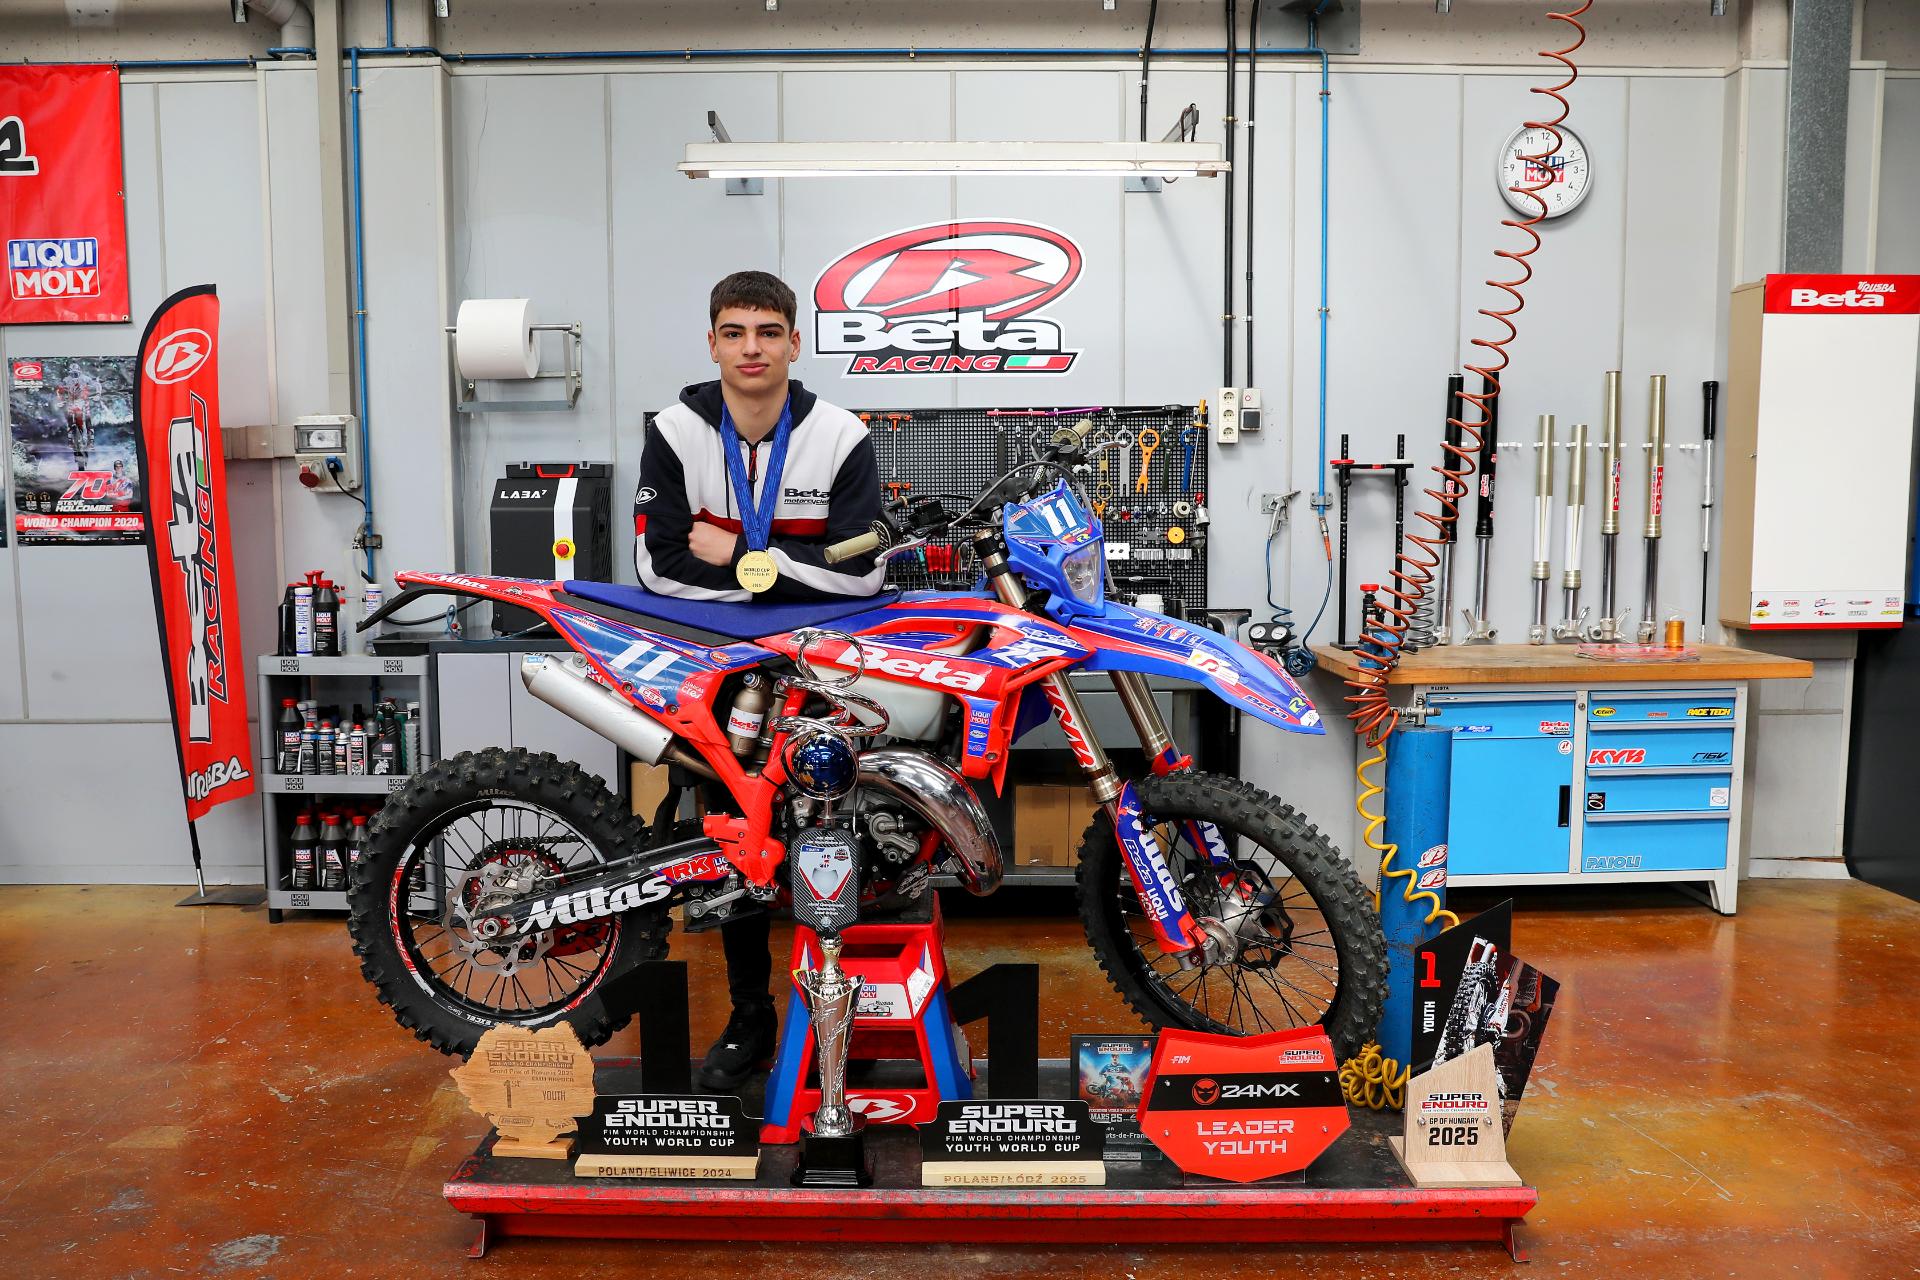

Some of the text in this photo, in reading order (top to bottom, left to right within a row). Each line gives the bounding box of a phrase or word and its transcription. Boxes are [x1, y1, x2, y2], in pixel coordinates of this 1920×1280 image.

[1526, 137, 1534, 145] 11
[1541, 132, 1551, 141] 12
[1570, 150, 1575, 158] 2
[1526, 169, 1564, 181] MOY
[1573, 166, 1579, 174] 3
[1556, 193, 1562, 202] 5
[12, 240, 94, 268] LIQUI
[14, 269, 97, 296] MOLY
[1791, 288, 1884, 307] Beta
[817, 310, 1061, 352] Beta
[851, 355, 1002, 372] RACING
[59, 470, 114, 500] 70
[1655, 465, 1664, 515] Beta
[784, 487, 831, 498] Beta
[24, 517, 139, 528] WORLD CHAMPION 2020
[1040, 497, 1078, 537] 11
[169, 420, 210, 738] Beta
[437, 574, 490, 590] Mitas
[196, 486, 224, 697] RACING
[609, 640, 683, 682] 11
[835, 644, 987, 692] Beta
[972, 710, 990, 719] LIQUI
[1686, 708, 1731, 716] RACE TECH
[971, 716, 989, 725] MOLY
[1588, 750, 1645, 765] KYB
[671, 856, 711, 882] RK
[1123, 838, 1154, 886] Beta
[1586, 856, 1641, 869] PAIOLI
[518, 874, 672, 935] Mitas
[1138, 892, 1160, 923] MOLY
[1146, 887, 1169, 921] LIQUI
[1420, 951, 1441, 988] 1
[856, 1003, 890, 1013] eta
[466, 1013, 492, 1026] EXCEL
[1422, 1000, 1436, 1034] YOUTH
[495, 1040, 566, 1051] SUPER
[487, 1051, 575, 1064] ENDURO
[1170, 1055, 1192, 1064] FIM
[542, 1090, 567, 1101] YOUTH
[1220, 1083, 1301, 1098] 24MX
[1428, 1093, 1483, 1101] SUPER
[616, 1099, 719, 1114] SUPER
[960, 1104, 1065, 1119] SUPER
[1421, 1100, 1488, 1109] ENDURO
[604, 1113, 731, 1129] ENDURO
[1090, 1113, 1123, 1123] MARS 25
[1429, 1117, 1479, 1125] GP OF HUNGARY
[663, 1129, 735, 1137] CHAMPIONSHIP
[948, 1119, 1077, 1133] ENDURO
[1196, 1119, 1295, 1136] LEADER
[603, 1137, 735, 1147] YOUTH WORLD CUP
[1428, 1126, 1479, 1146] 2025
[946, 1143, 1081, 1152] YOUTH WORLD CUP
[1202, 1139, 1288, 1156] YOUTH
[598, 1166, 732, 1178] POLAND/GLIWICE 2024
[944, 1173, 1087, 1184] POLAND/ŁÓDŹ 2025
